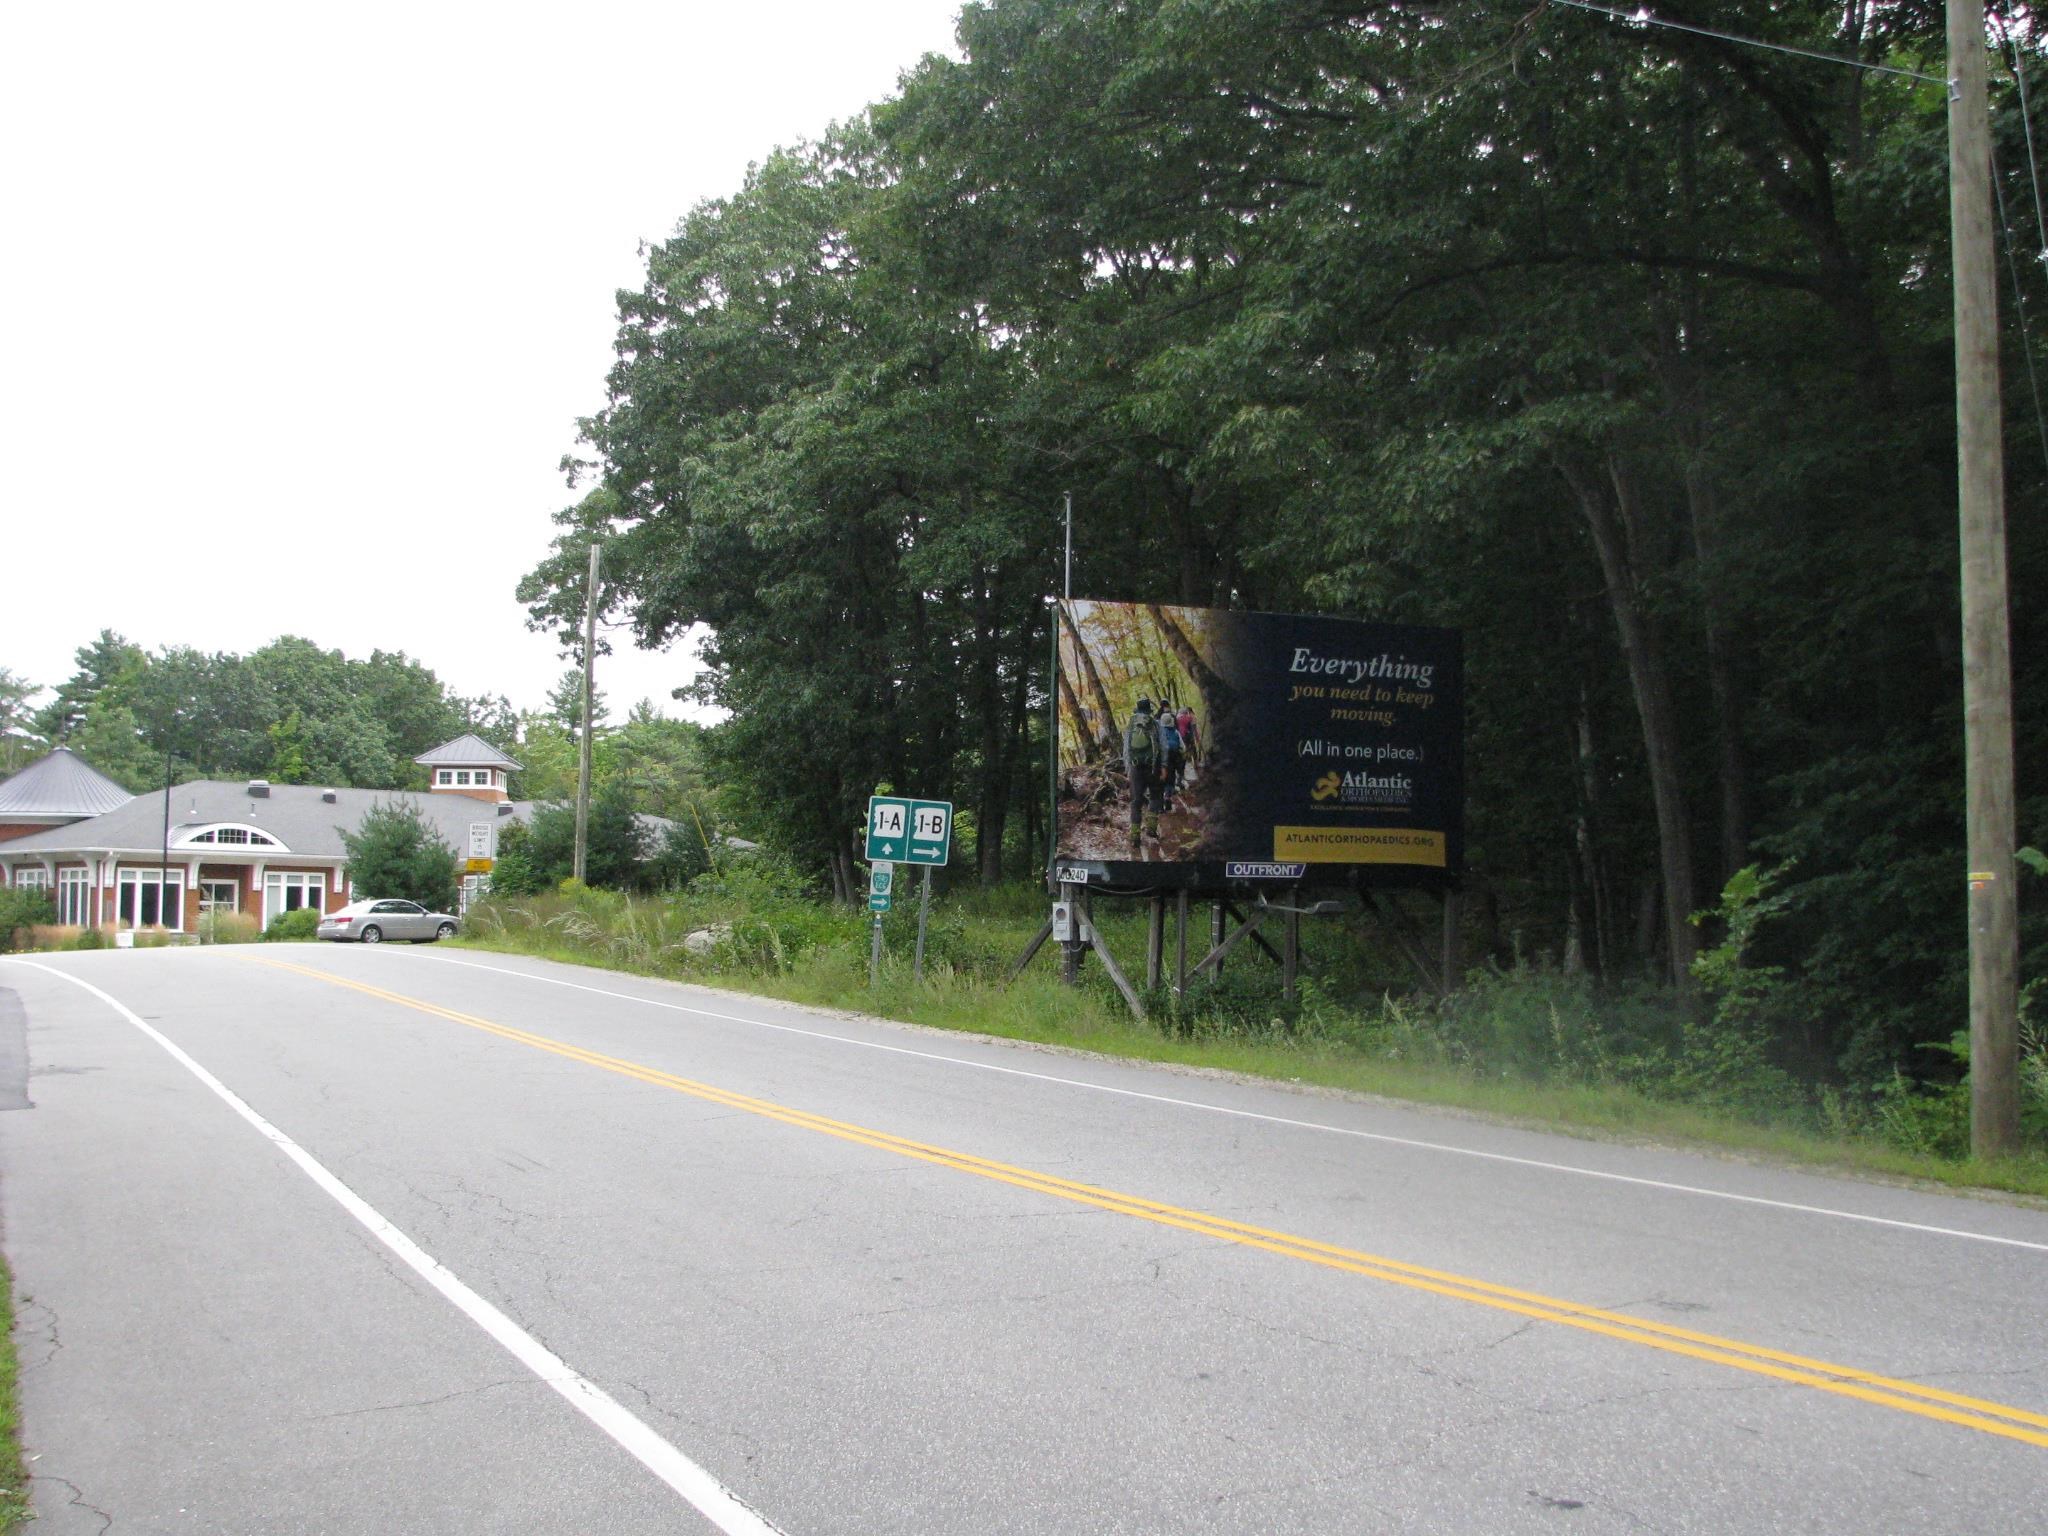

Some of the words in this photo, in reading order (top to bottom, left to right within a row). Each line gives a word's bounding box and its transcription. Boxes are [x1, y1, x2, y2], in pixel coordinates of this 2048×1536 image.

[1289, 647, 1434, 688] Everything
[1288, 685, 1325, 702] you
[1330, 684, 1370, 701] need
[1375, 687, 1391, 702] to
[1396, 686, 1434, 709] keep
[1330, 706, 1397, 726] moving.
[1297, 739, 1321, 758] (All
[1327, 741, 1339, 757] in
[1345, 746, 1372, 758] one
[1377, 743, 1424, 763] place.)
[1341, 770, 1412, 789] Atlantic
[880, 811, 901, 831] 1-A
[919, 814, 943, 834] 1-B
[1285, 833, 1434, 847] ATLANTICORTHOPAEDICS.ORG
[1233, 863, 1297, 876] OUTFRONT
